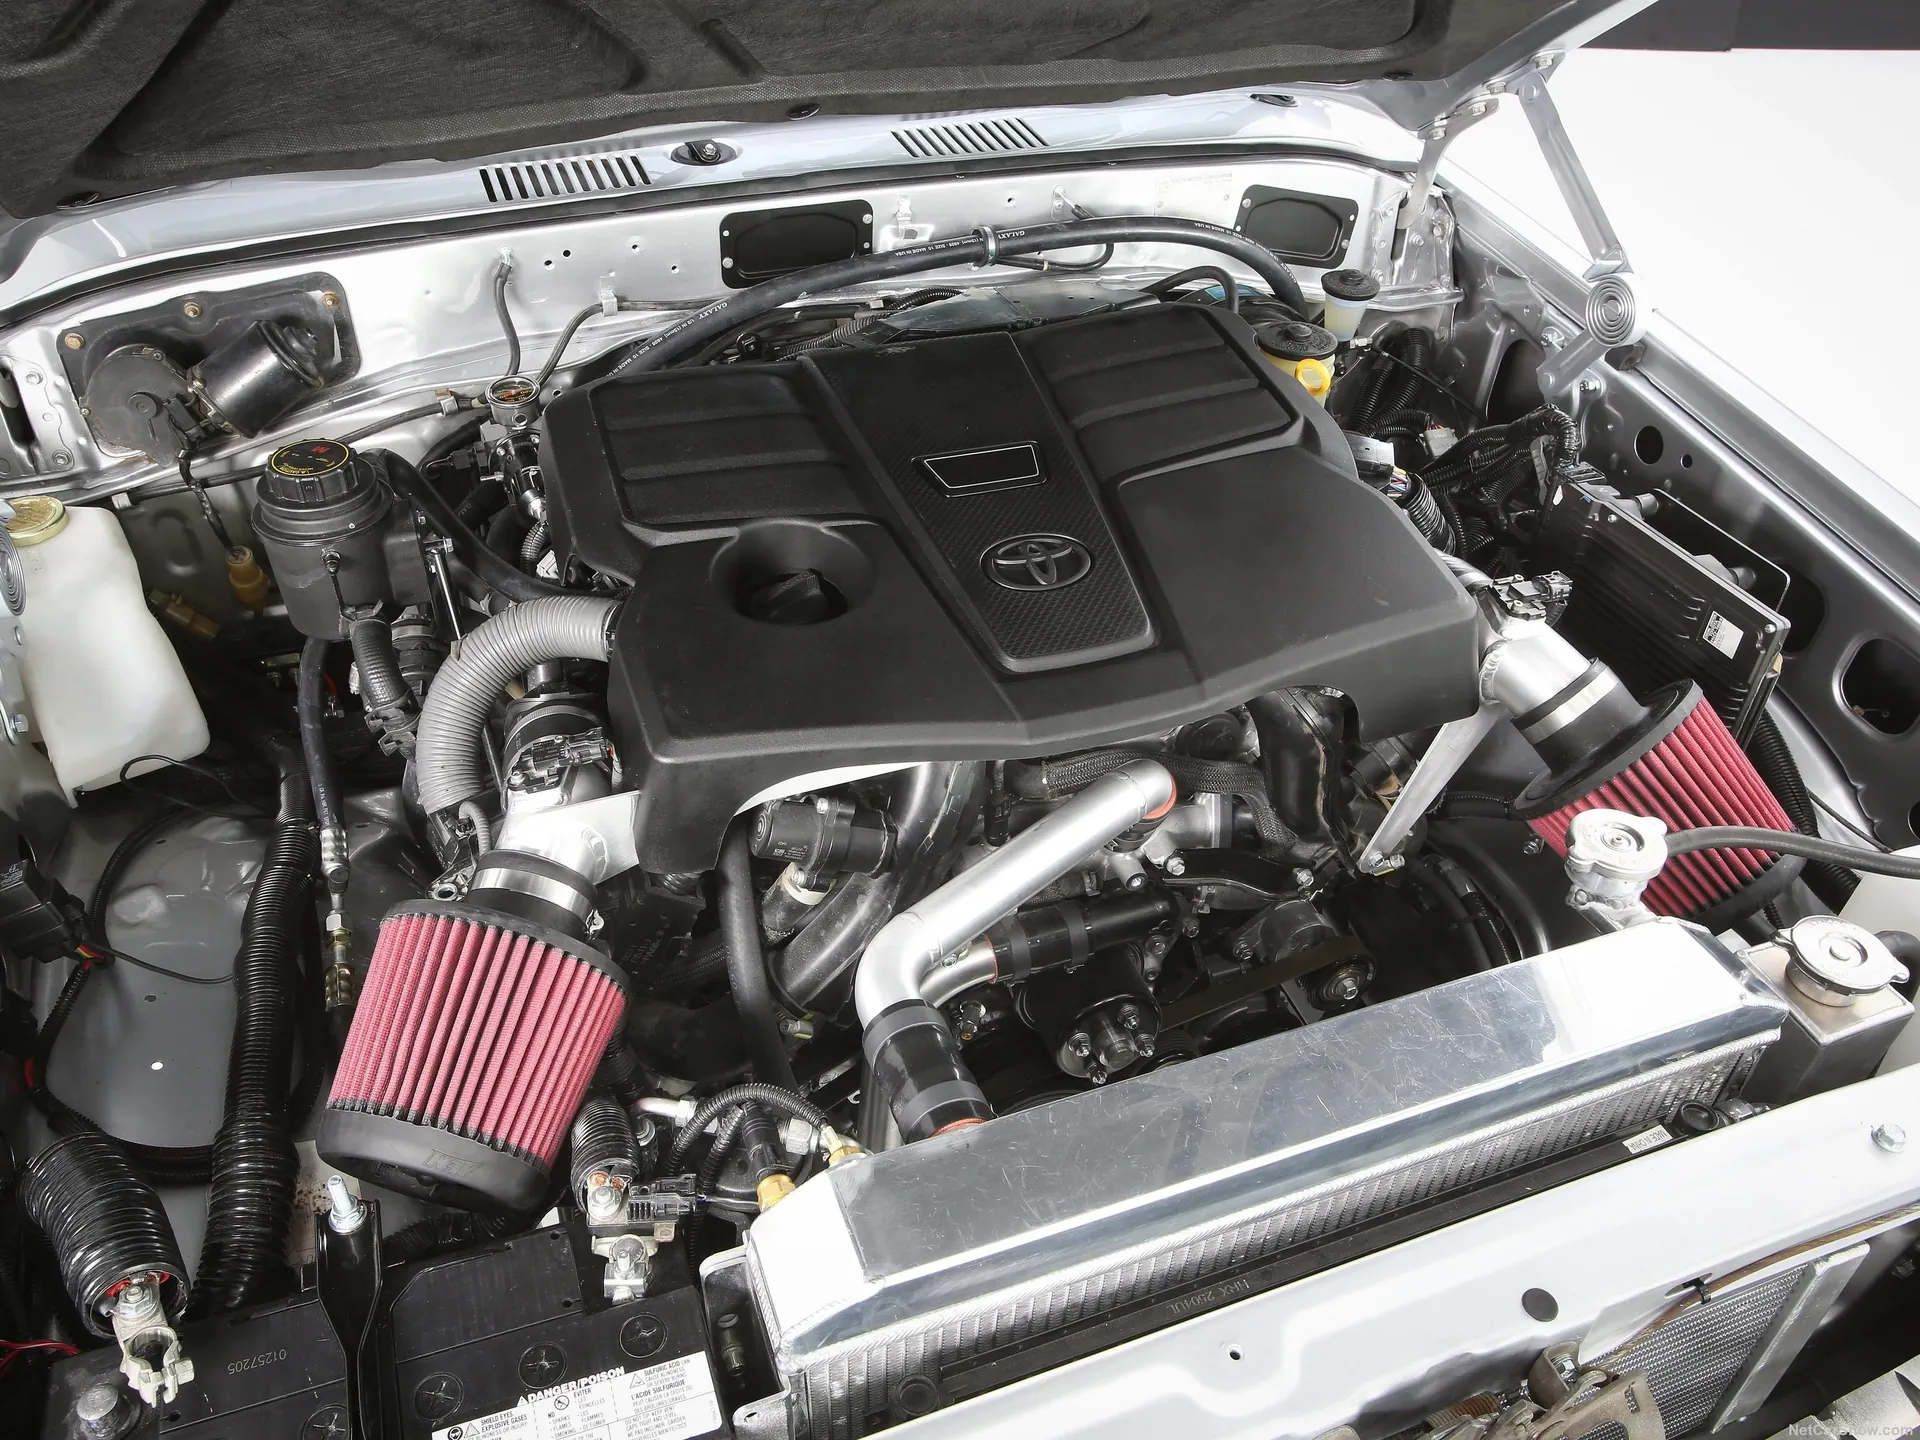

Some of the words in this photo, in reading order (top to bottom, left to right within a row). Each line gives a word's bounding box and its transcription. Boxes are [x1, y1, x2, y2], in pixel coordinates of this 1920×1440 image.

[698, 302, 728, 320] GALAXY
[639, 345, 650, 355] SIZE
[618, 358, 632, 370] MADE
[227, 1348, 287, 1375] 01257205
[644, 1364, 667, 1376] SULFURIC
[669, 1360, 680, 1369] ACID
[527, 1366, 625, 1402] DANGER/POISON
[631, 1389, 651, 1400] L'ACIDE
[653, 1379, 685, 1394] SULFURIQUE
[481, 1415, 499, 1426] SHIELD
[500, 1411, 513, 1420] EYES
[482, 1419, 510, 1433] EXPLOSIVE
[511, 1414, 527, 1424] GASES
[626, 1422, 638, 1431] CAPS
